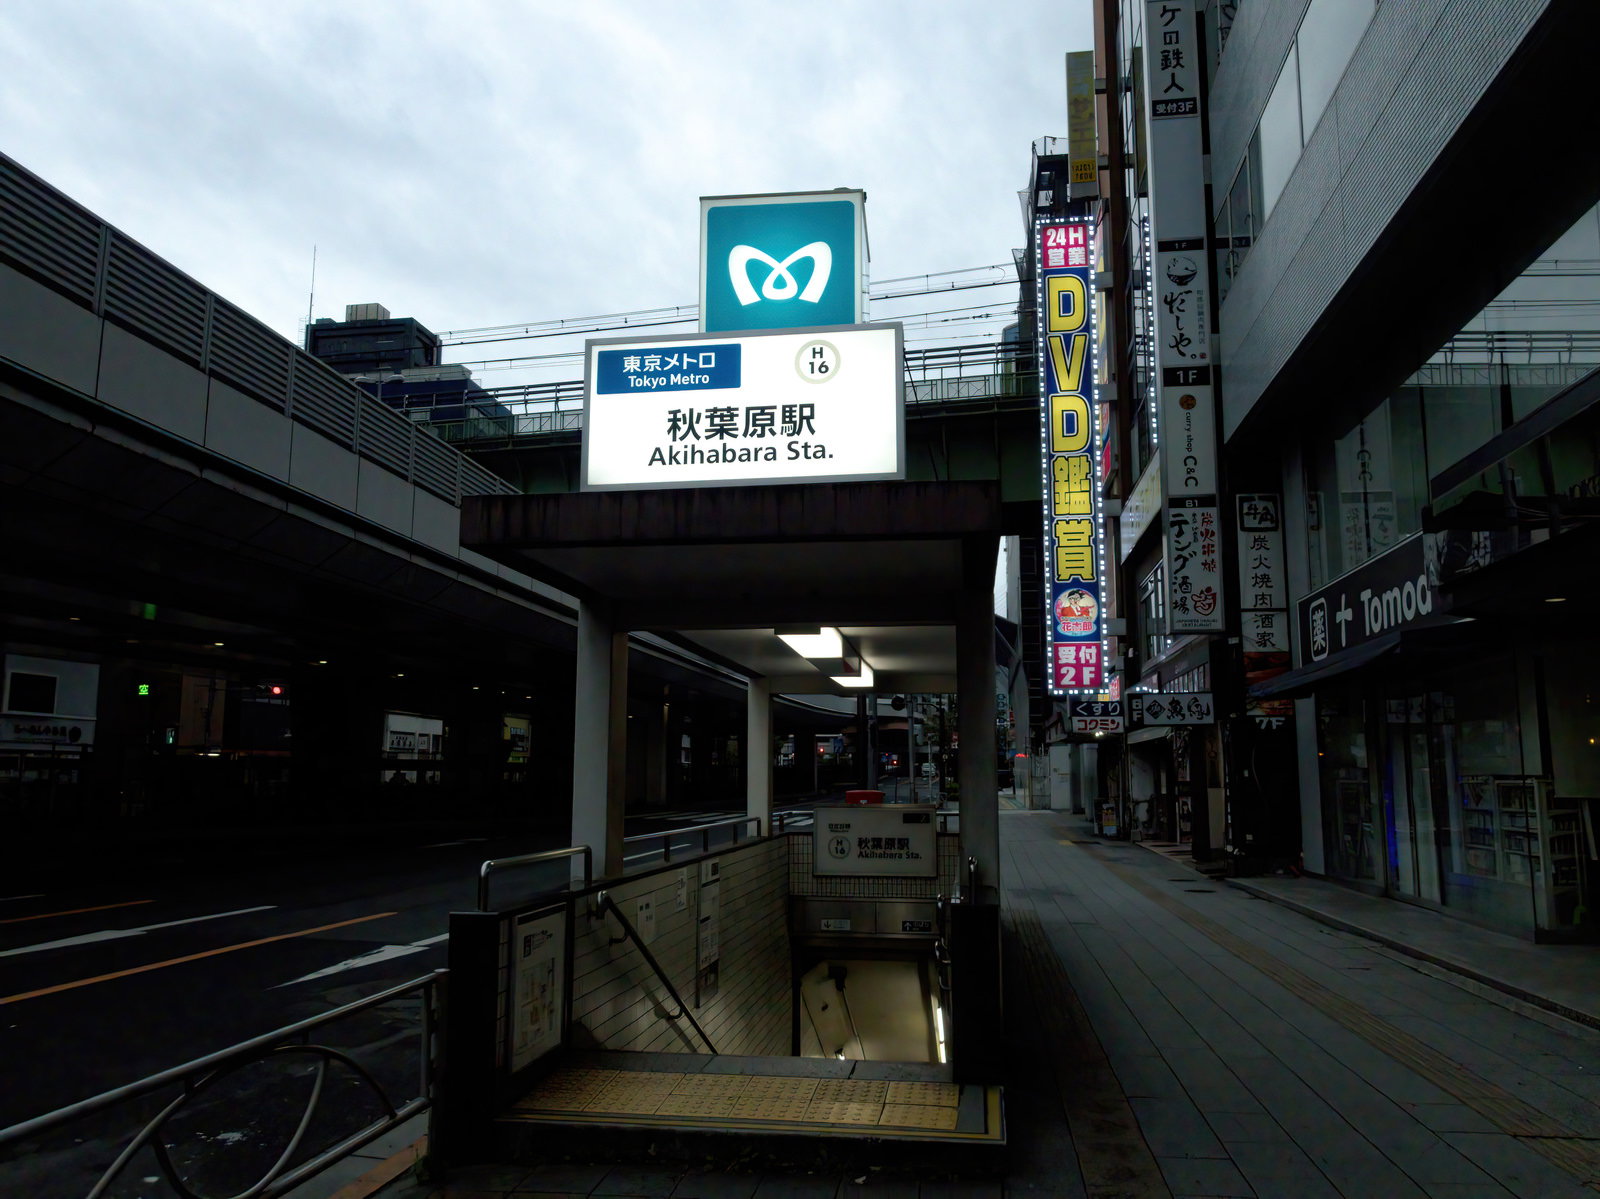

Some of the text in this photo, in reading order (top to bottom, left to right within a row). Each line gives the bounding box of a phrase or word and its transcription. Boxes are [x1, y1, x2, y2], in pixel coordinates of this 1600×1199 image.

[1159, 4, 1185, 94] ケの鉄人
[1155, 101, 1194, 114] 受付3F
[1046, 226, 1084, 247] 24H
[1174, 242, 1188, 250] 1F
[1047, 246, 1086, 268] 営業
[622, 351, 716, 373] 東京メトロ
[812, 346, 824, 360] H
[808, 360, 830, 375] 16
[627, 372, 711, 389] Tokyo Metro
[1175, 369, 1201, 385] 1F
[666, 402, 817, 442] 秋葉原駅
[647, 440, 835, 467] Akihabara Sta.
[1185, 499, 1199, 508] B1
[1243, 502, 1276, 526] 牛角
[1250, 535, 1274, 609] 炭火焼肉
[1253, 612, 1276, 649] 酒家
[1311, 607, 1328, 653] 薬
[1057, 646, 1098, 665] 受付
[1059, 665, 1098, 686] 2F
[1075, 701, 1121, 717] くすり
[1077, 718, 1120, 731] コクミン
[834, 846, 846, 855] 16
[857, 837, 910, 850] 秋葉原駅
[857, 850, 922, 860] Akihabara Sta.
